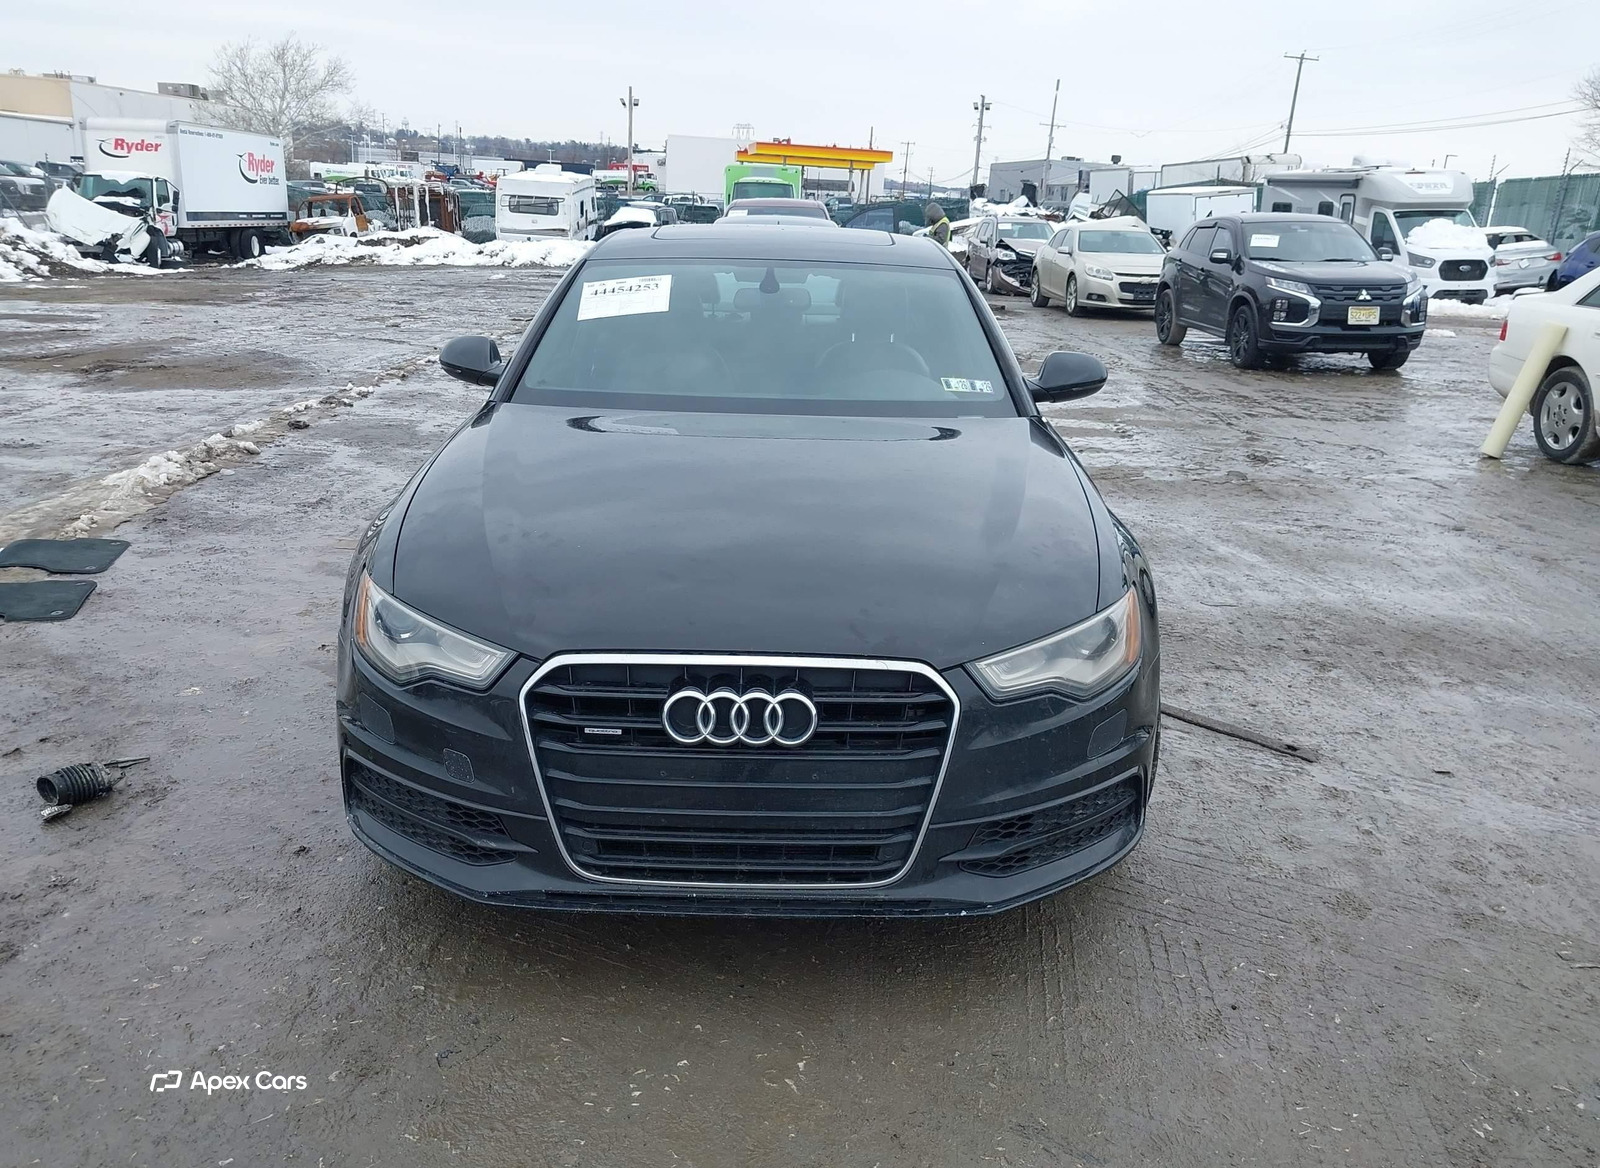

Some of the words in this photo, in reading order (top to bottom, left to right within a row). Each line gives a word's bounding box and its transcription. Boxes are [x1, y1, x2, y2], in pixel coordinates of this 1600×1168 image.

[114, 138, 161, 154] Ryder
[248, 152, 275, 176] Ryder
[590, 283, 660, 296] 44454253
